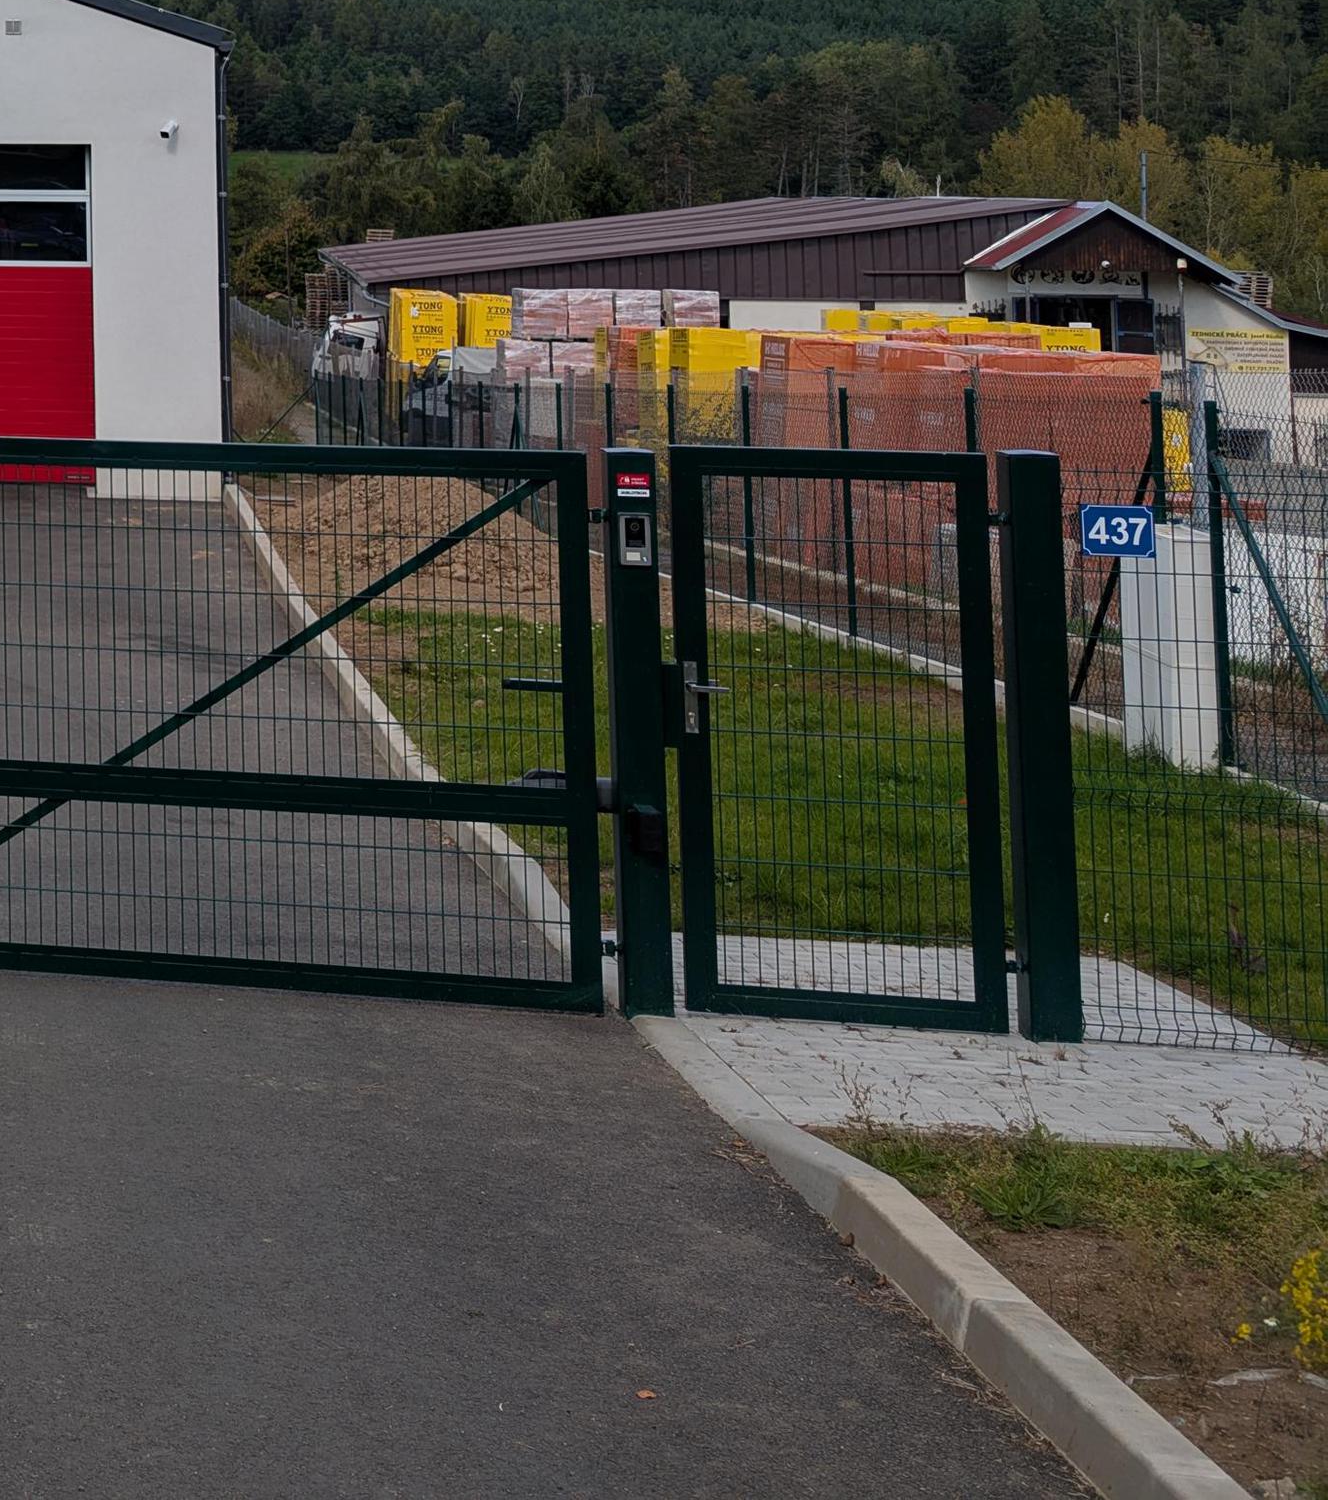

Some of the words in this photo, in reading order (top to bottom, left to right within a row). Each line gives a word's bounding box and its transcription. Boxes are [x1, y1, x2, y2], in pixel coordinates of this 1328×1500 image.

[411, 301, 443, 310] YTONG
[486, 306, 512, 314] YTON
[412, 325, 444, 334] YTONG
[1088, 516, 1148, 546] 437
